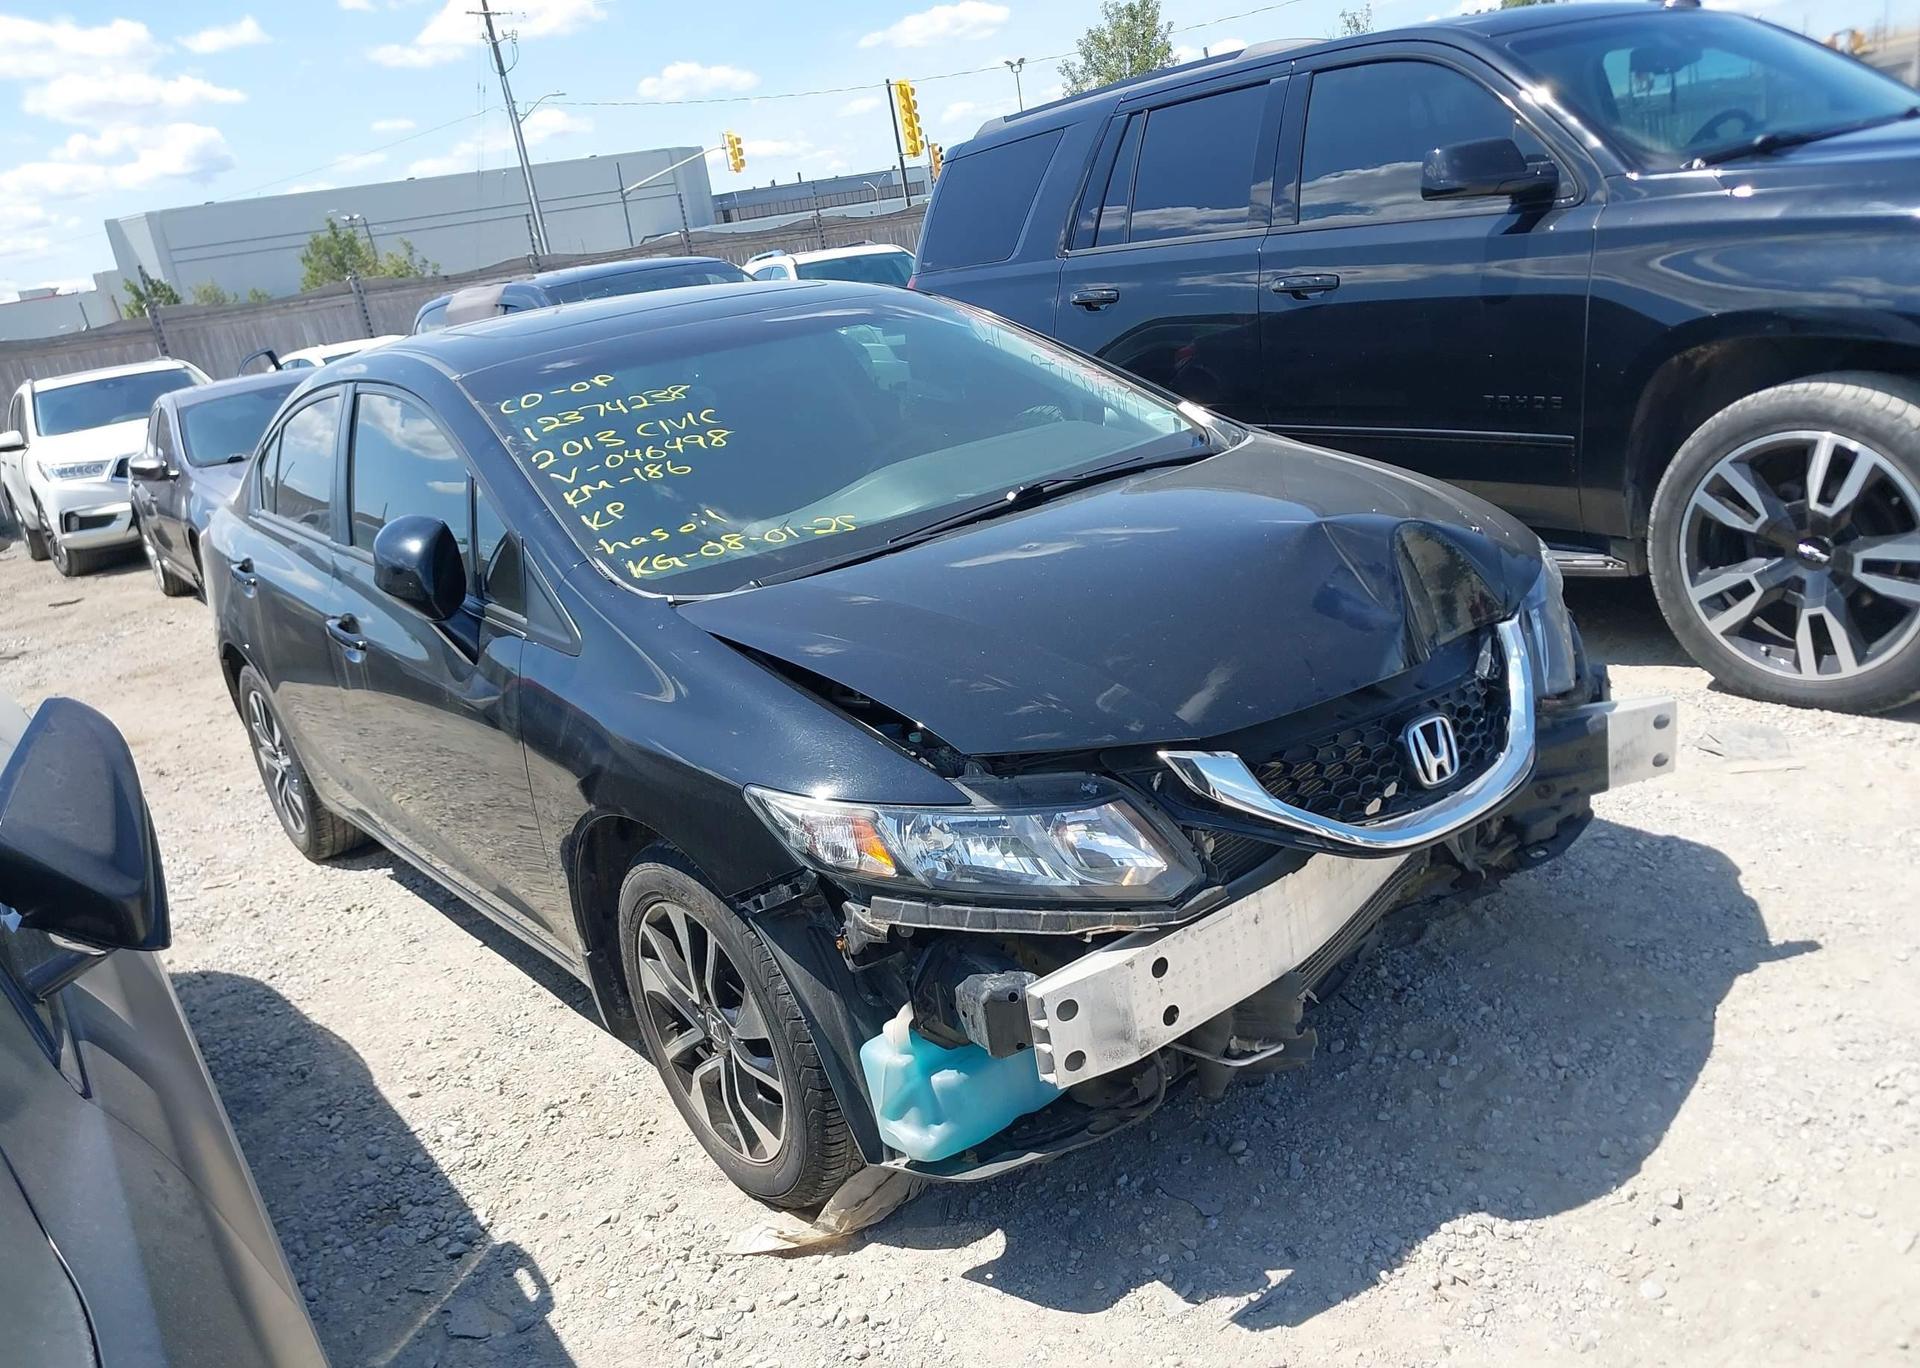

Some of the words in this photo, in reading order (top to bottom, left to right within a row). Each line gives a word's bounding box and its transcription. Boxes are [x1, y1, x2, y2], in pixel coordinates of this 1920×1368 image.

[523, 384, 691, 442] 12374238
[531, 430, 626, 470] 2013
[636, 408, 723, 437] CIVIC
[549, 429, 736, 484] V-046498
[562, 460, 692, 508] KM-186
[581, 501, 625, 531] KP
[597, 528, 670, 555] has
